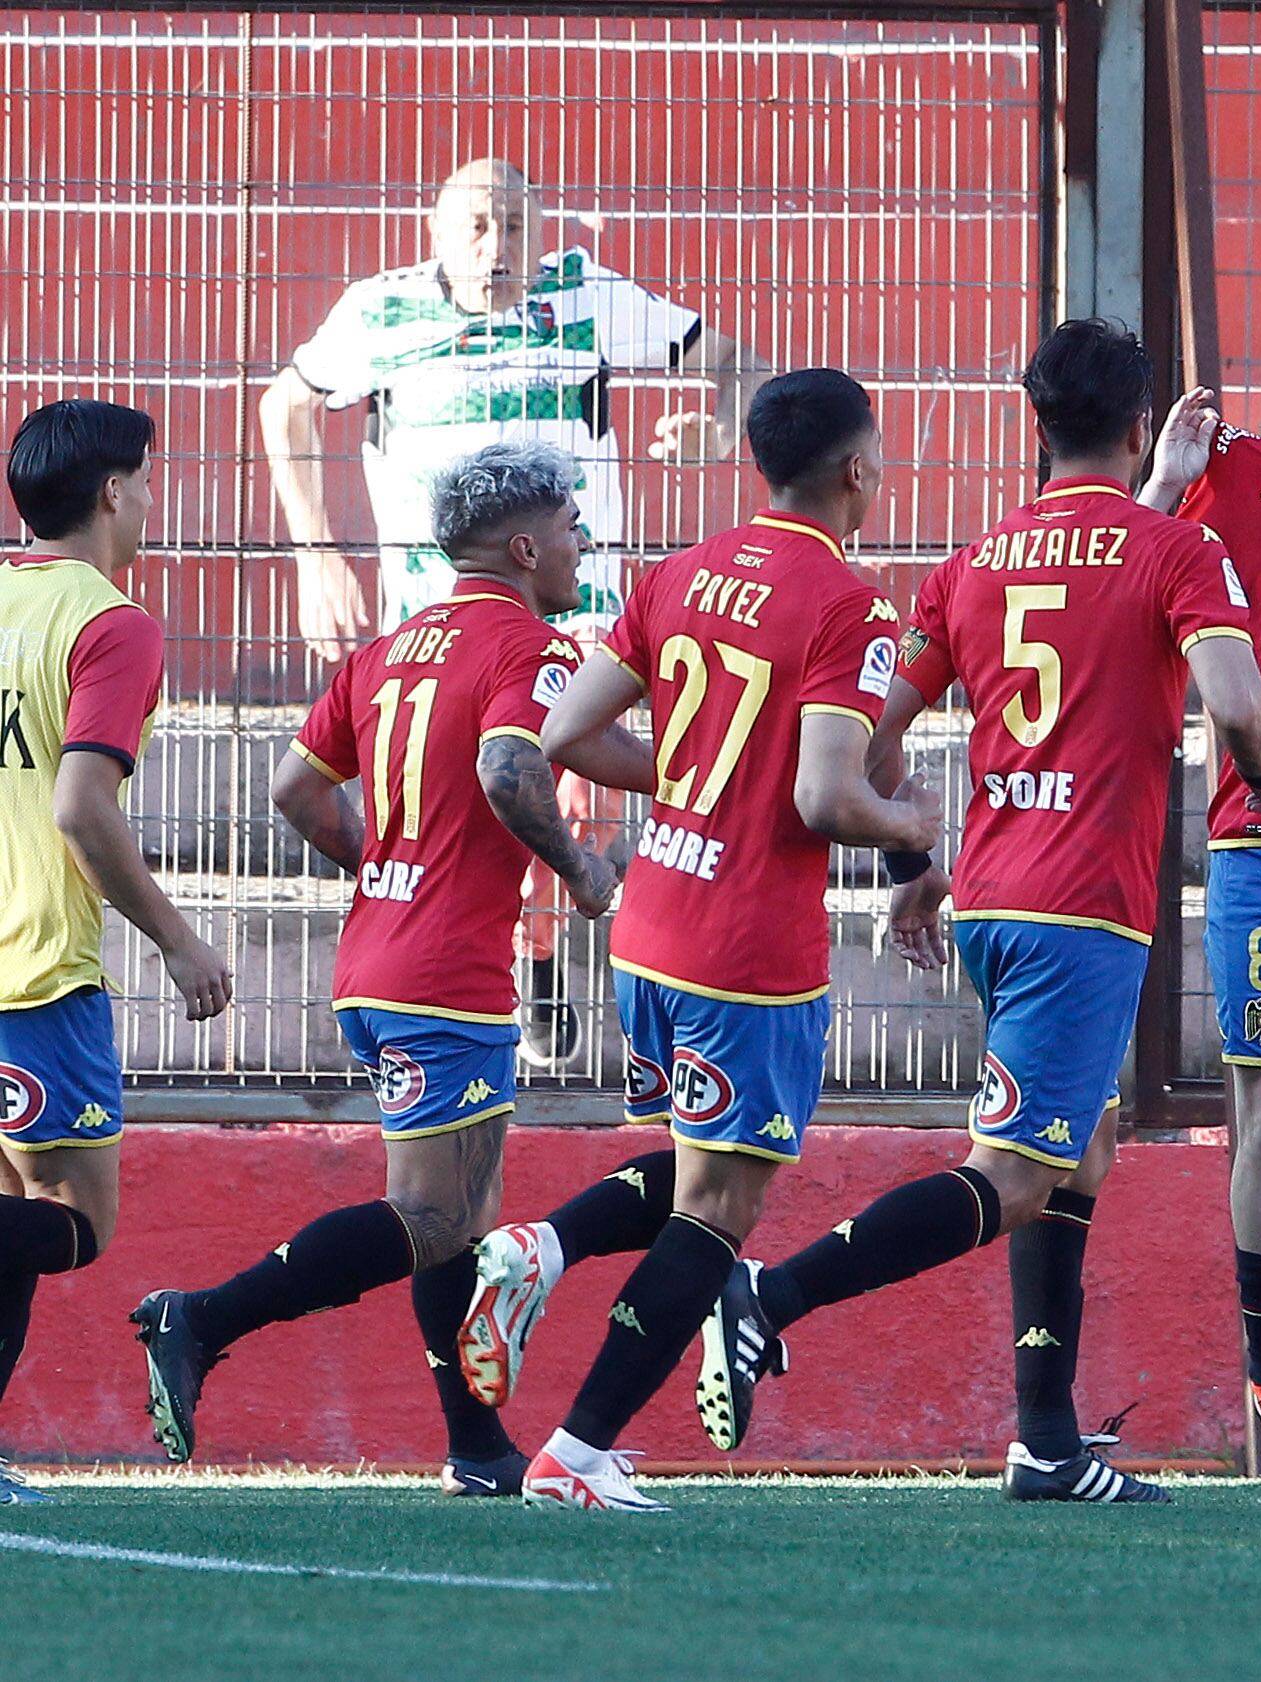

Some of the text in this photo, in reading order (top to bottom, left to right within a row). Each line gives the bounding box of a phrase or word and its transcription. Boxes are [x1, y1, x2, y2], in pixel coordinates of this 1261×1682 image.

[970, 527, 1129, 571] GONZALEZ
[683, 567, 773, 629] PAVEZ
[1001, 584, 1068, 748] 5
[655, 634, 773, 816] 27
[370, 678, 438, 840] 11
[984, 771, 1075, 812] SORE
[637, 817, 725, 881] SCORE
